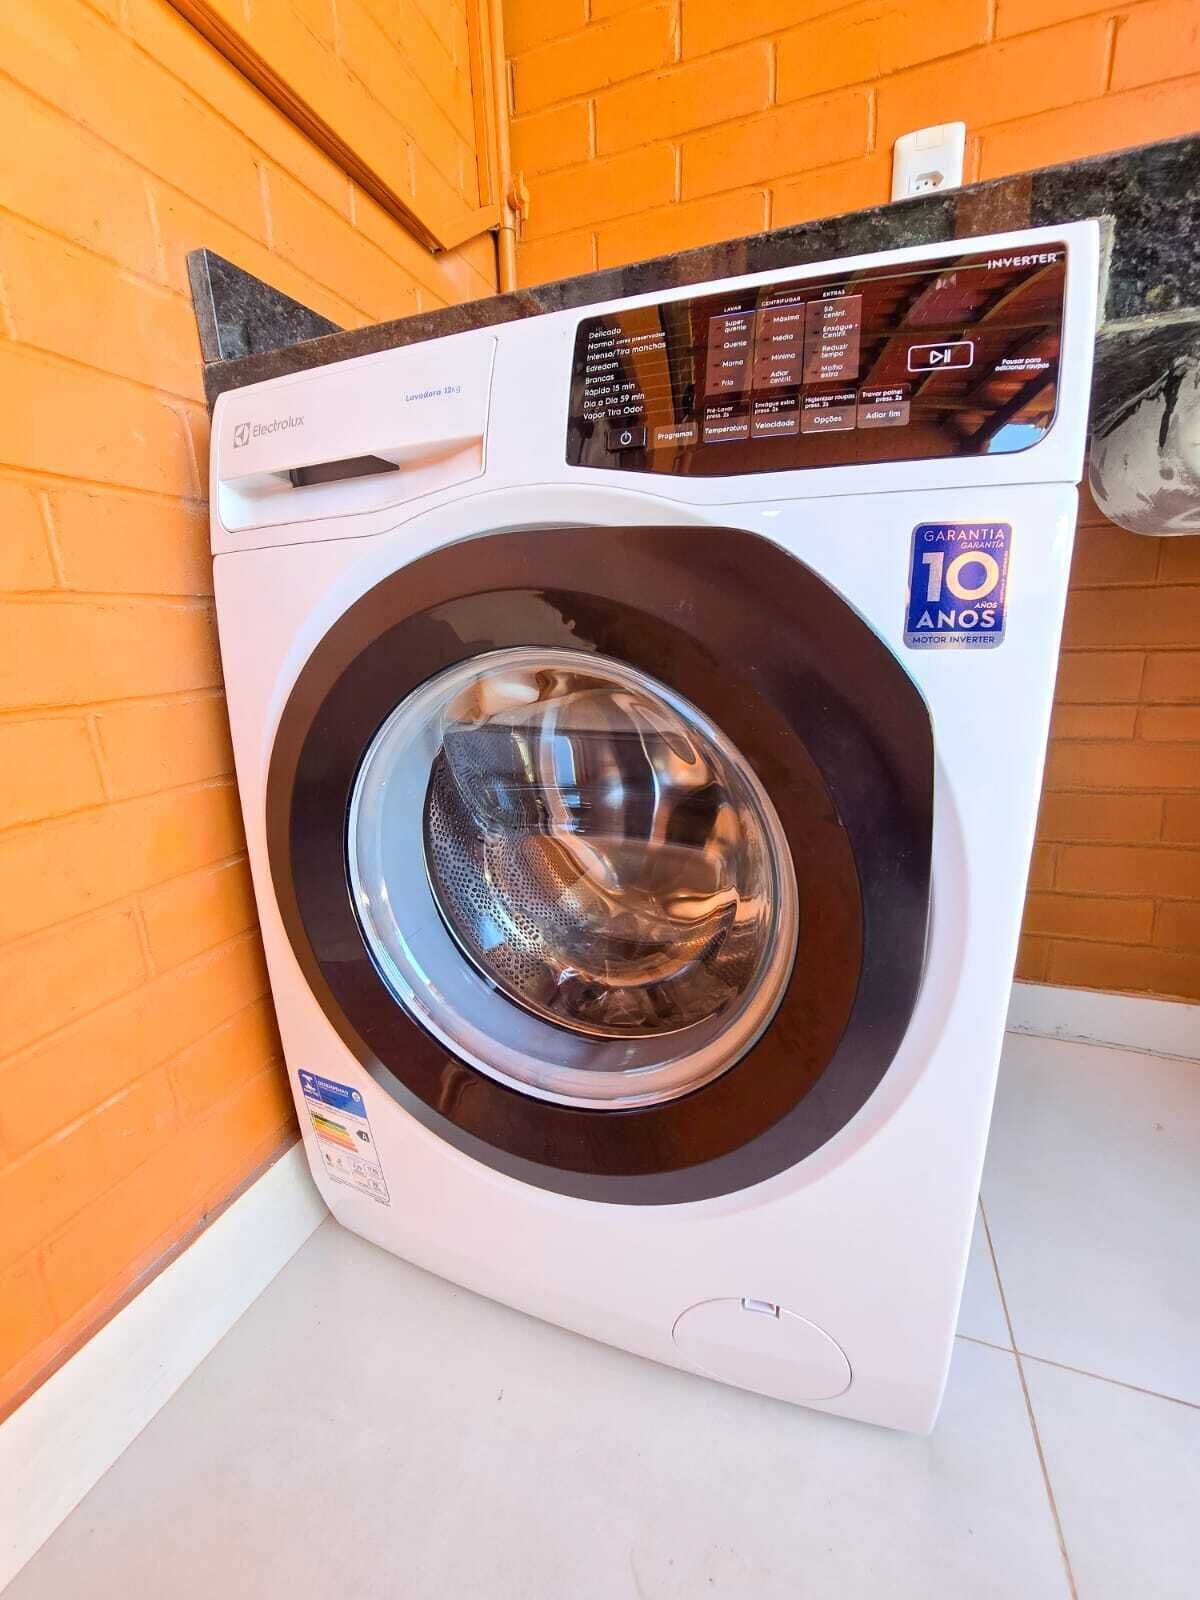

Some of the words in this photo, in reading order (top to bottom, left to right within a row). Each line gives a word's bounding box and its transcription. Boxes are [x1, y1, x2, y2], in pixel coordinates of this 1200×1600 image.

[988, 253, 1056, 269] INVERTER
[823, 290, 845, 298] EXTRAS
[762, 296, 801, 307] CENTRIFUGAR
[824, 305, 834, 313] Só
[725, 319, 744, 327] Super
[773, 314, 800, 323] Máxima
[724, 325, 747, 334] quente
[823, 324, 853, 333] Enxágue
[589, 328, 621, 339] Delicado
[772, 333, 794, 342] Média
[588, 340, 614, 350] Normal
[724, 340, 747, 349] Quente
[822, 343, 849, 352] Reduzir
[587, 348, 630, 361] Intenso/Tira
[632, 342, 666, 353] manchas
[821, 350, 844, 359] tempo
[586, 362, 618, 373] Edredom
[722, 360, 744, 368] Morna
[1026, 362, 1049, 370] roupas
[770, 370, 789, 378] Adiar
[820, 371, 839, 379] extra
[585, 374, 614, 384] Brancas
[405, 389, 441, 402] Lavadora
[444, 385, 462, 395] 12kg
[584, 386, 610, 397] Rápido
[622, 382, 635, 390] min
[584, 400, 596, 409] Dia
[605, 396, 618, 405] Dia
[620, 394, 630, 402] 59
[631, 393, 645, 401] min
[583, 411, 605, 420] Vapor
[608, 407, 621, 416] Tira
[623, 405, 643, 414] Odor
[866, 411, 887, 419] Adiar
[814, 415, 842, 424] Opções
[253, 415, 304, 438] Electrolux
[755, 420, 795, 429] Velocidade
[705, 425, 748, 434] Temperatura
[657, 430, 693, 440] Programas
[924, 529, 1005, 542] GARANTIA
[961, 541, 1004, 549] GARANTÍA
[922, 551, 999, 602] 10
[974, 601, 998, 609] AÑOS
[916, 609, 995, 628] ANOS
[912, 636, 946, 644] MOTOR
[950, 635, 995, 644] INVERTER
